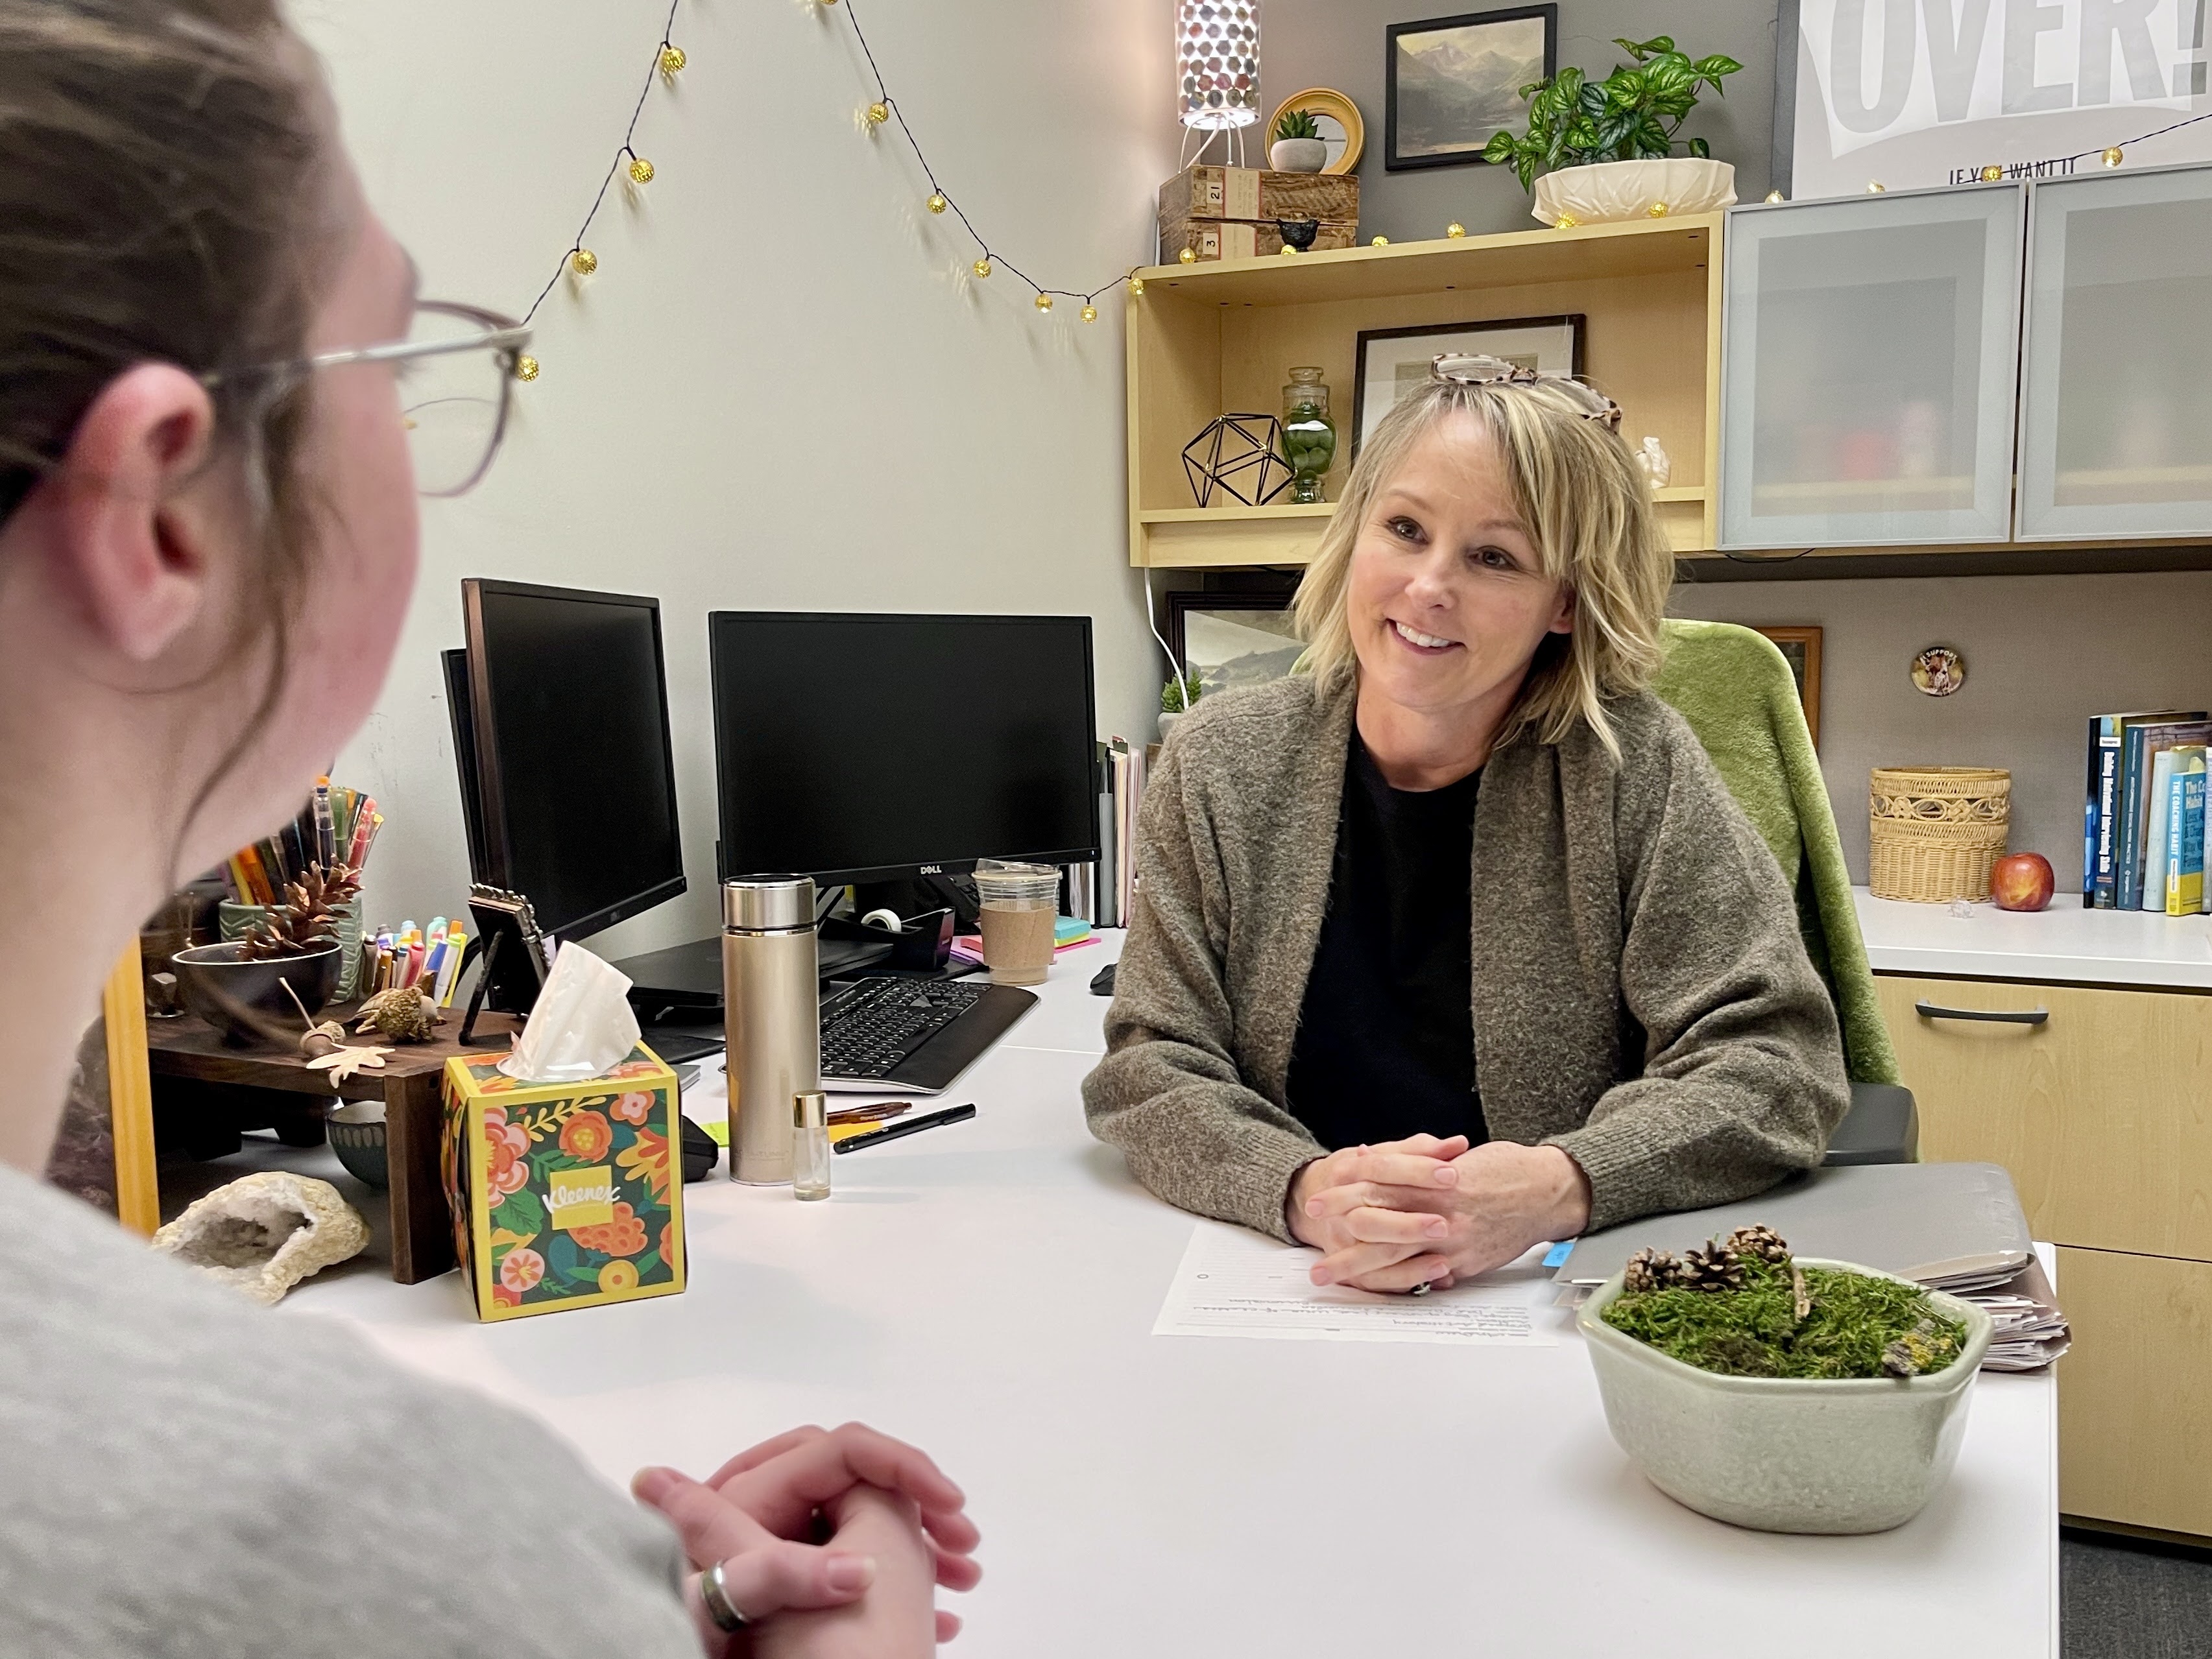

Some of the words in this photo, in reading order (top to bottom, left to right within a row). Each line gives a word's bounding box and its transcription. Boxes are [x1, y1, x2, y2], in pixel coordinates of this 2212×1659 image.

[2010, 160, 2054, 179] WANT
[1210, 186, 1220, 199] 21
[1925, 649, 1958, 659] SUPPORT
[2172, 780, 2181, 795] THE
[2170, 796, 2180, 832] COACHING
[2170, 834, 2179, 855] HABIT
[920, 865, 942, 874] DELL
[542, 1184, 621, 1214] Kleenex
